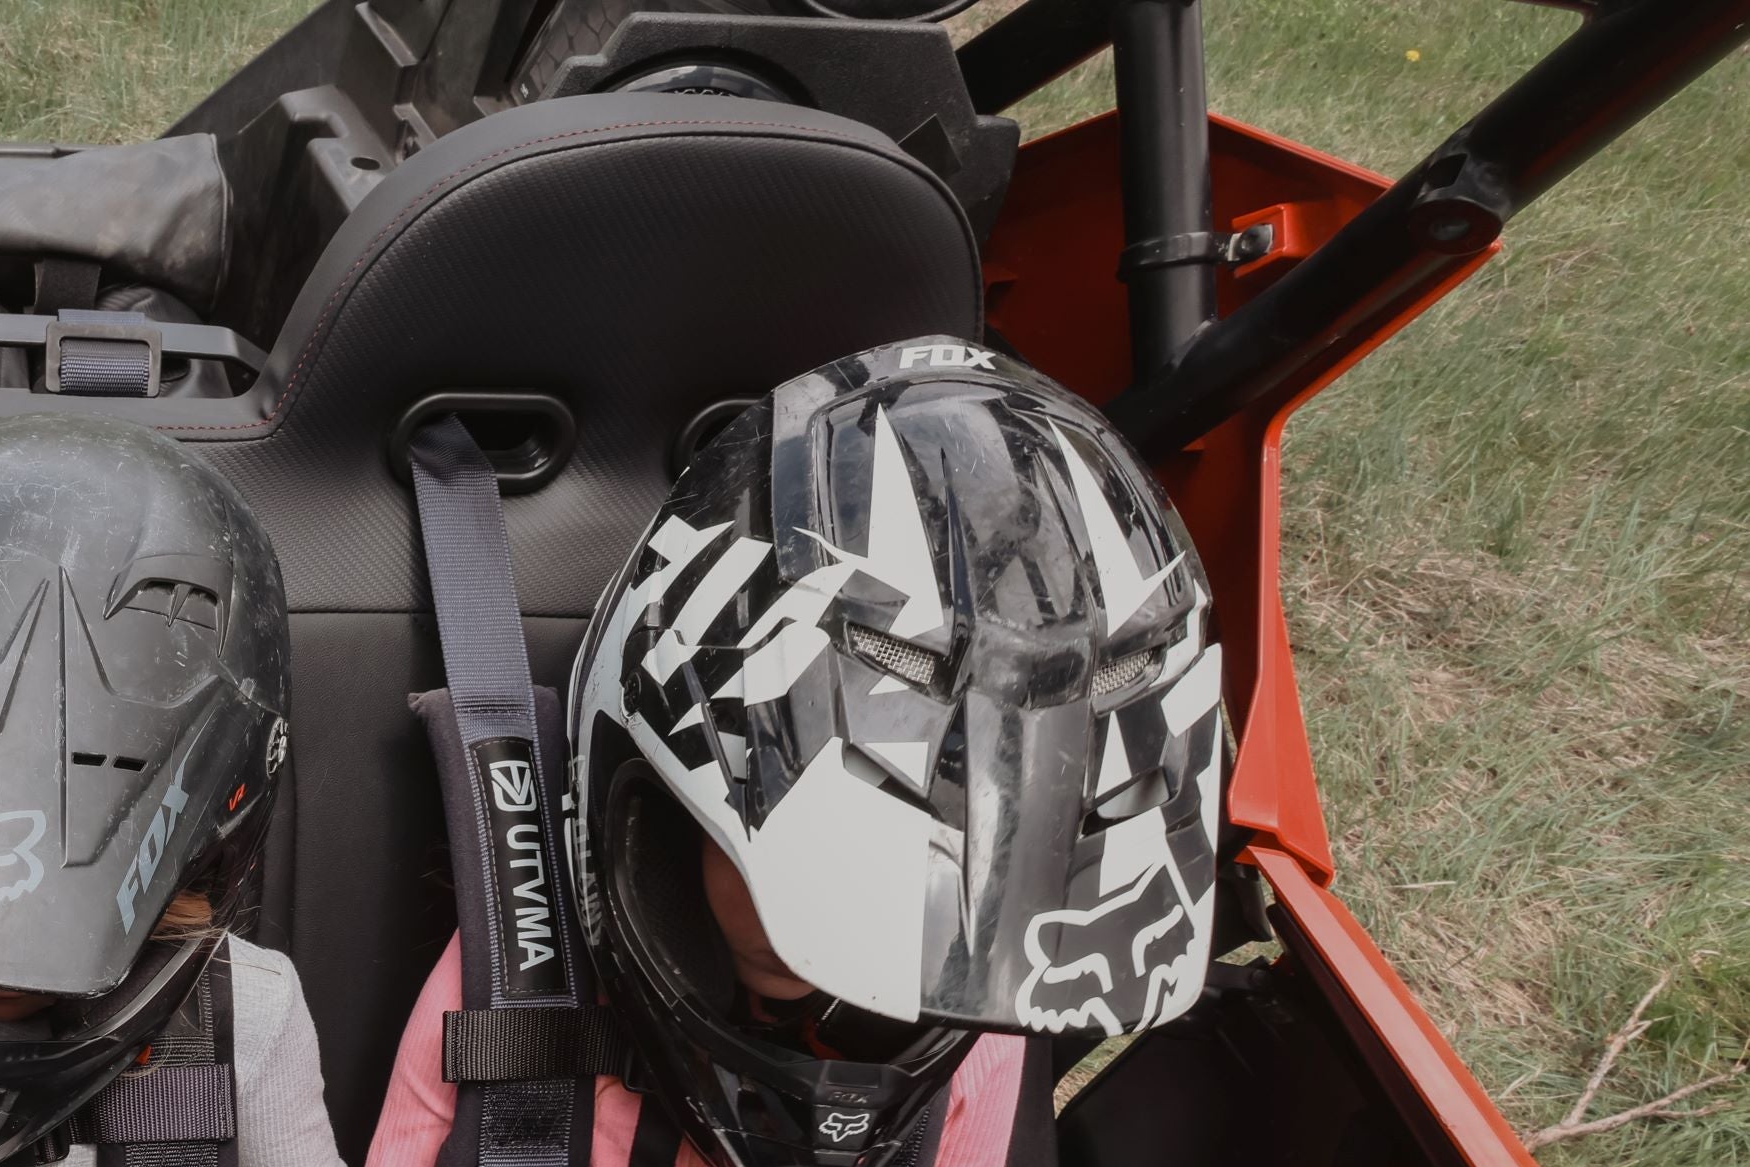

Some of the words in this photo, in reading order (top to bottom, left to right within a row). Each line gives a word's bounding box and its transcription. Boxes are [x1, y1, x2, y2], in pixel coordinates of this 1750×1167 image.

[898, 344, 997, 371] FOX
[116, 705, 217, 937] FOX
[505, 824, 555, 972] UTVMA
